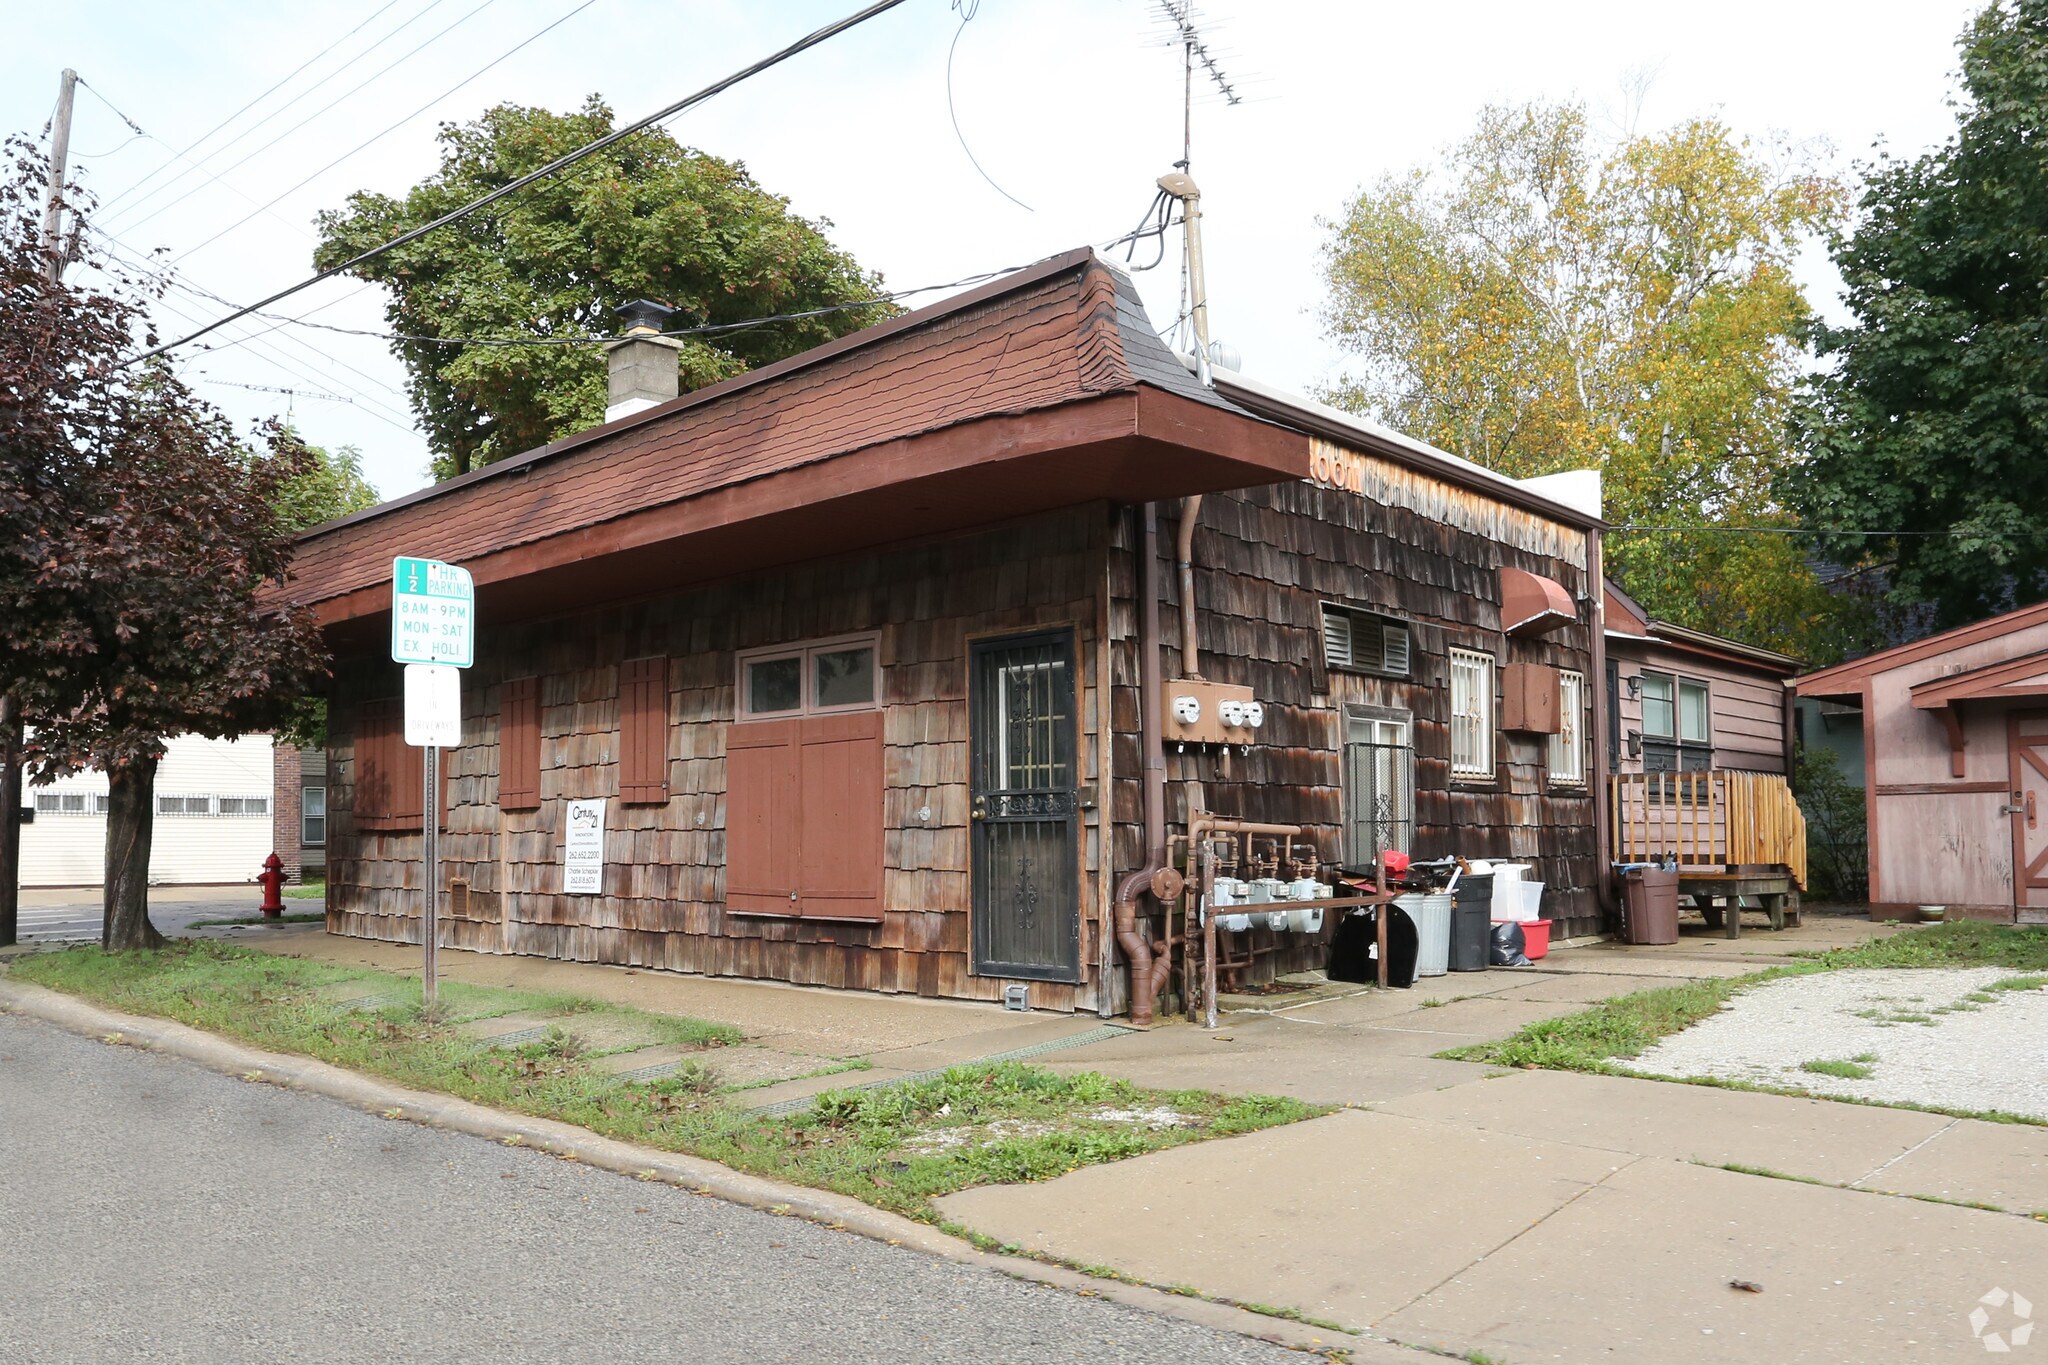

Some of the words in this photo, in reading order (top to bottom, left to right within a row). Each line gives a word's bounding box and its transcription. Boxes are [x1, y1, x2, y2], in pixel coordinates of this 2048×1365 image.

[1310, 452, 1362, 494] oom
[439, 567, 458, 582] HR
[429, 579, 469, 598] PARKING
[403, 620, 430, 635] MON
[441, 623, 463, 637] SAT
[411, 719, 456, 732] DRIVEWAYS
